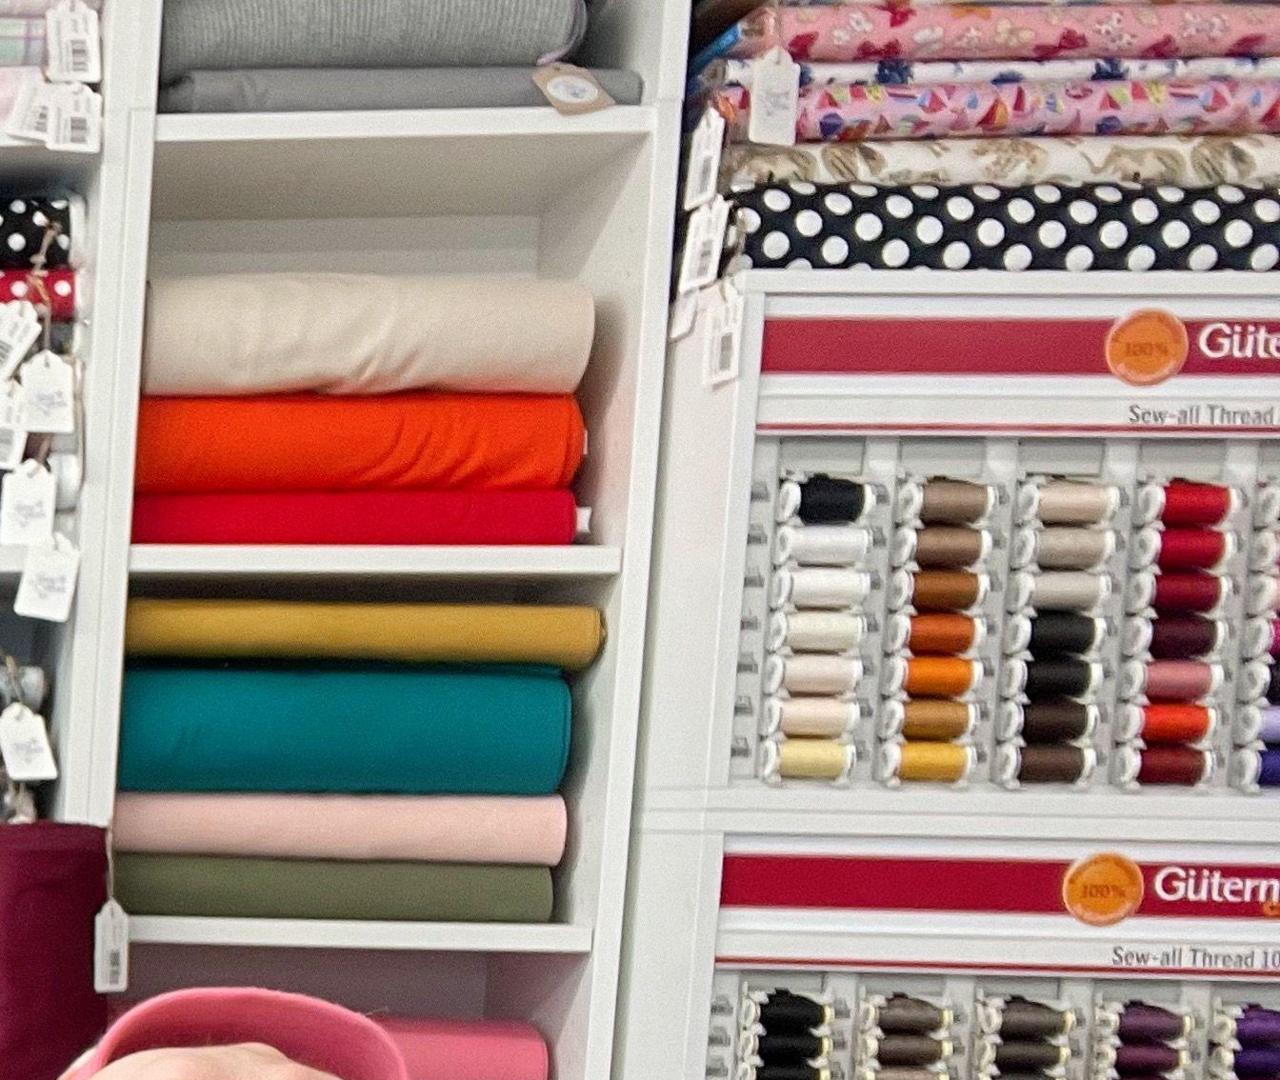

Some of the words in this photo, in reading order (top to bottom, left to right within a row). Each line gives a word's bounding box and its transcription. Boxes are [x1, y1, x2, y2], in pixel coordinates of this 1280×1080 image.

[1128, 404, 1200, 425] Sew-all
[1207, 404, 1274, 426] Thread
[1112, 946, 1183, 967] Sew-all
[1191, 948, 1255, 969] Thread
